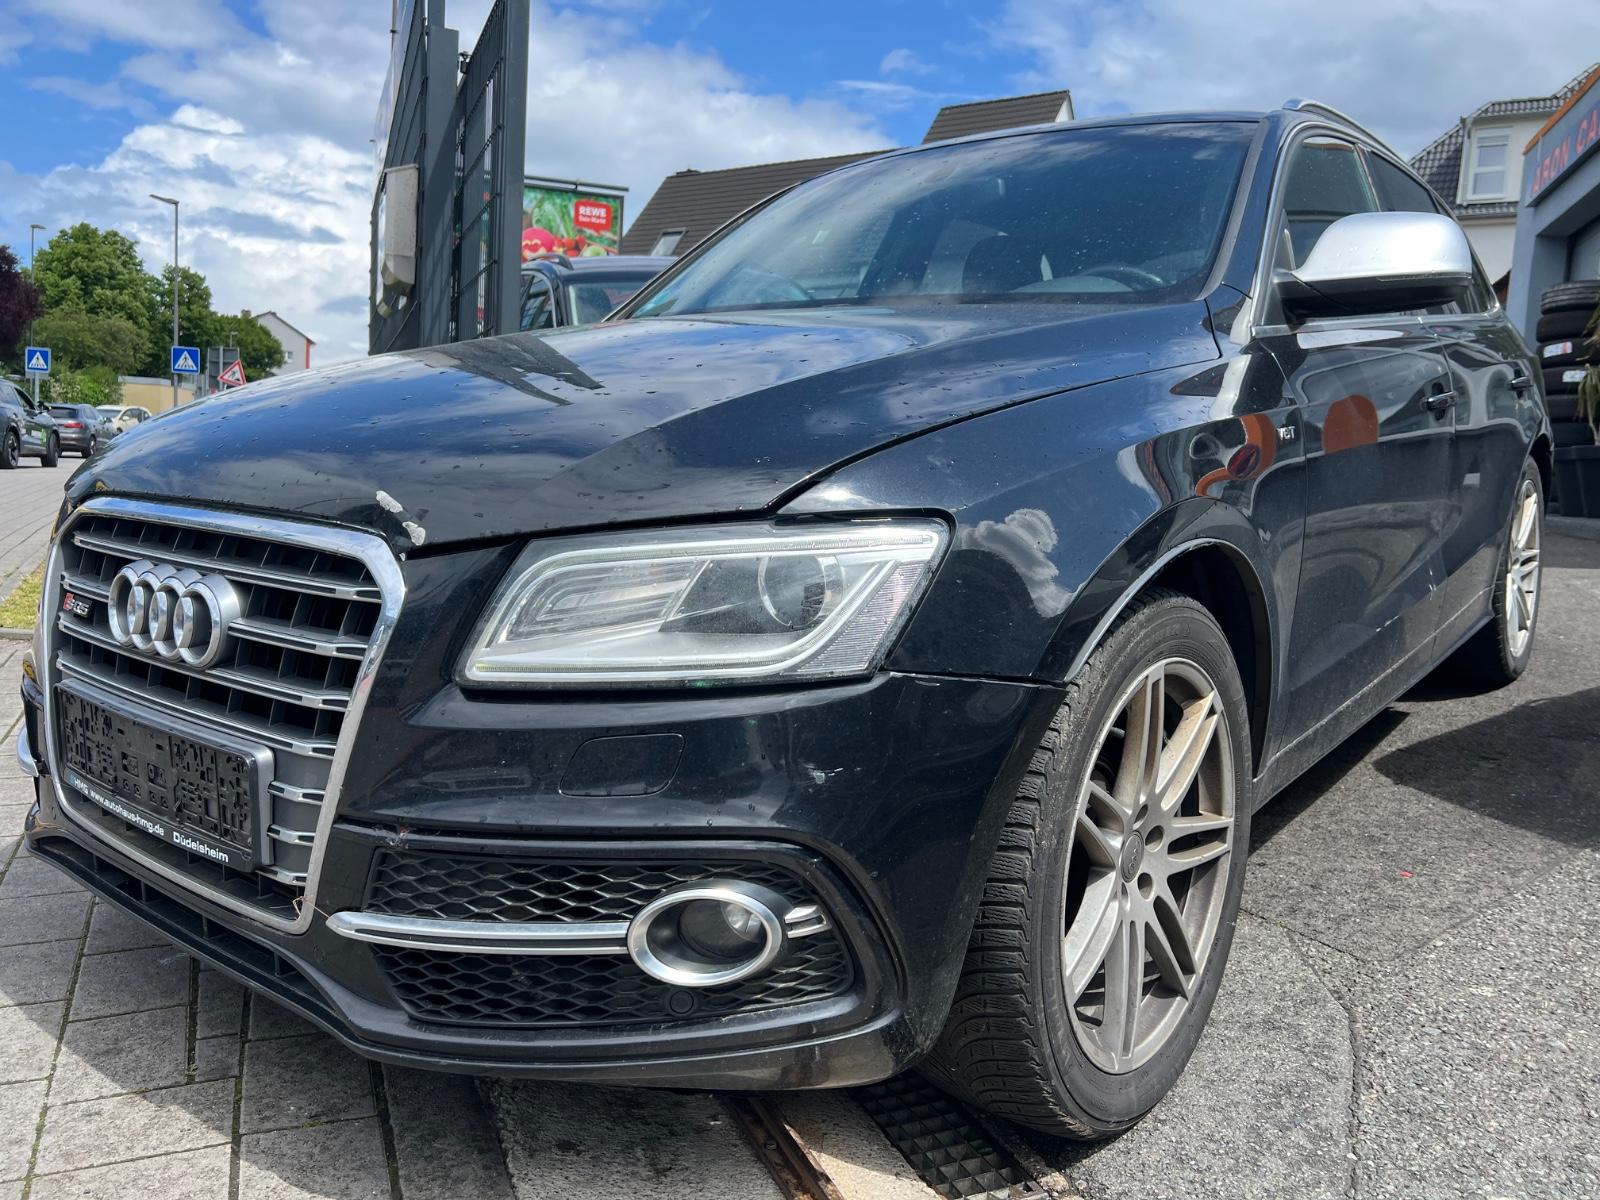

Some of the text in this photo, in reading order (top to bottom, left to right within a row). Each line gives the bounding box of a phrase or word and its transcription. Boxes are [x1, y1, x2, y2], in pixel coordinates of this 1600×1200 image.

[579, 205, 607, 217] REWE
[74, 776, 229, 863] HMG www.autohaus-hmg.de Düdelsheim
